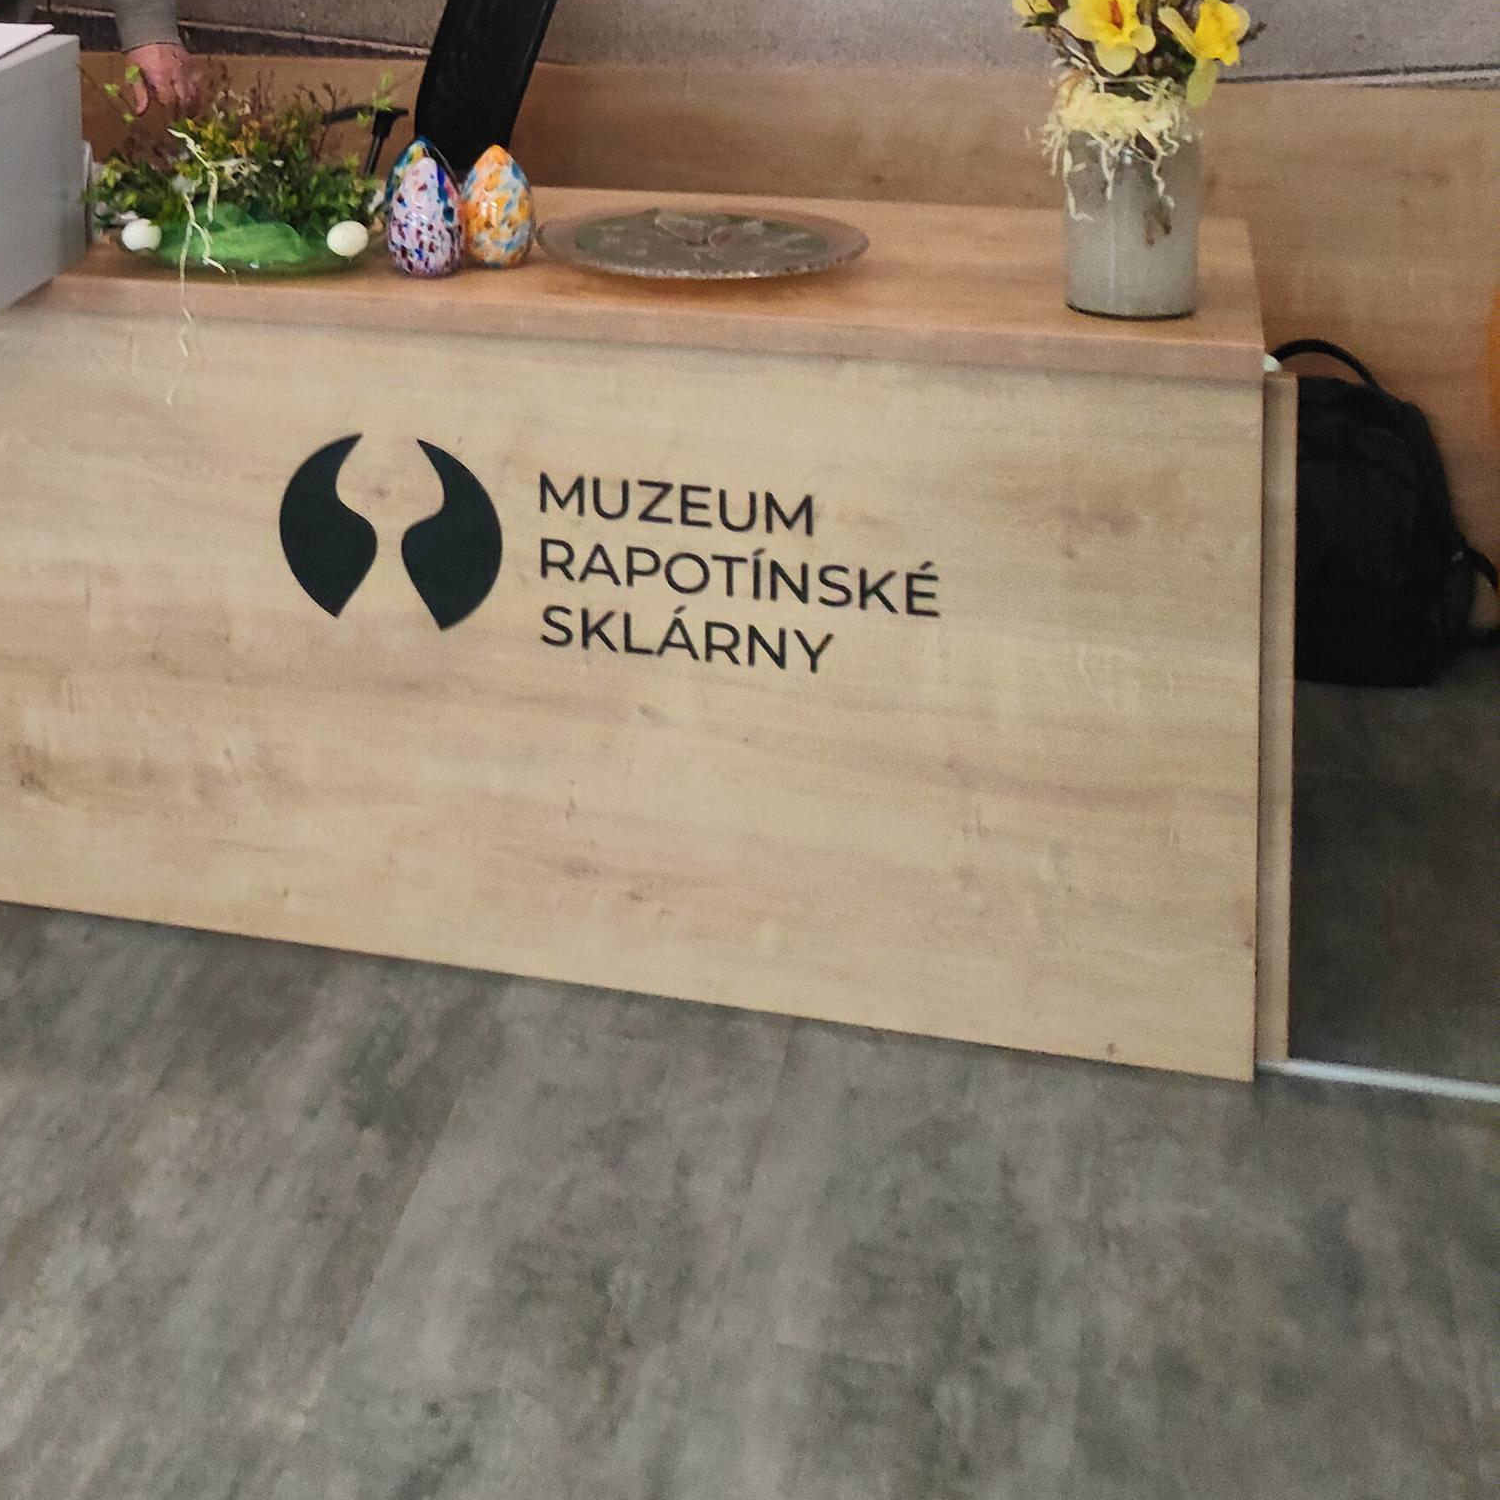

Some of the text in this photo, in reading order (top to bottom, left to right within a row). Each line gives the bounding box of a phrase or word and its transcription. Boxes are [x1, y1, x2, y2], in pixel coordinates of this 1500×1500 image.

[539, 471, 814, 538] MUZEUM
[539, 536, 941, 619] RAPOTÍNSKÉ
[539, 604, 835, 675] SKLÁRNY
